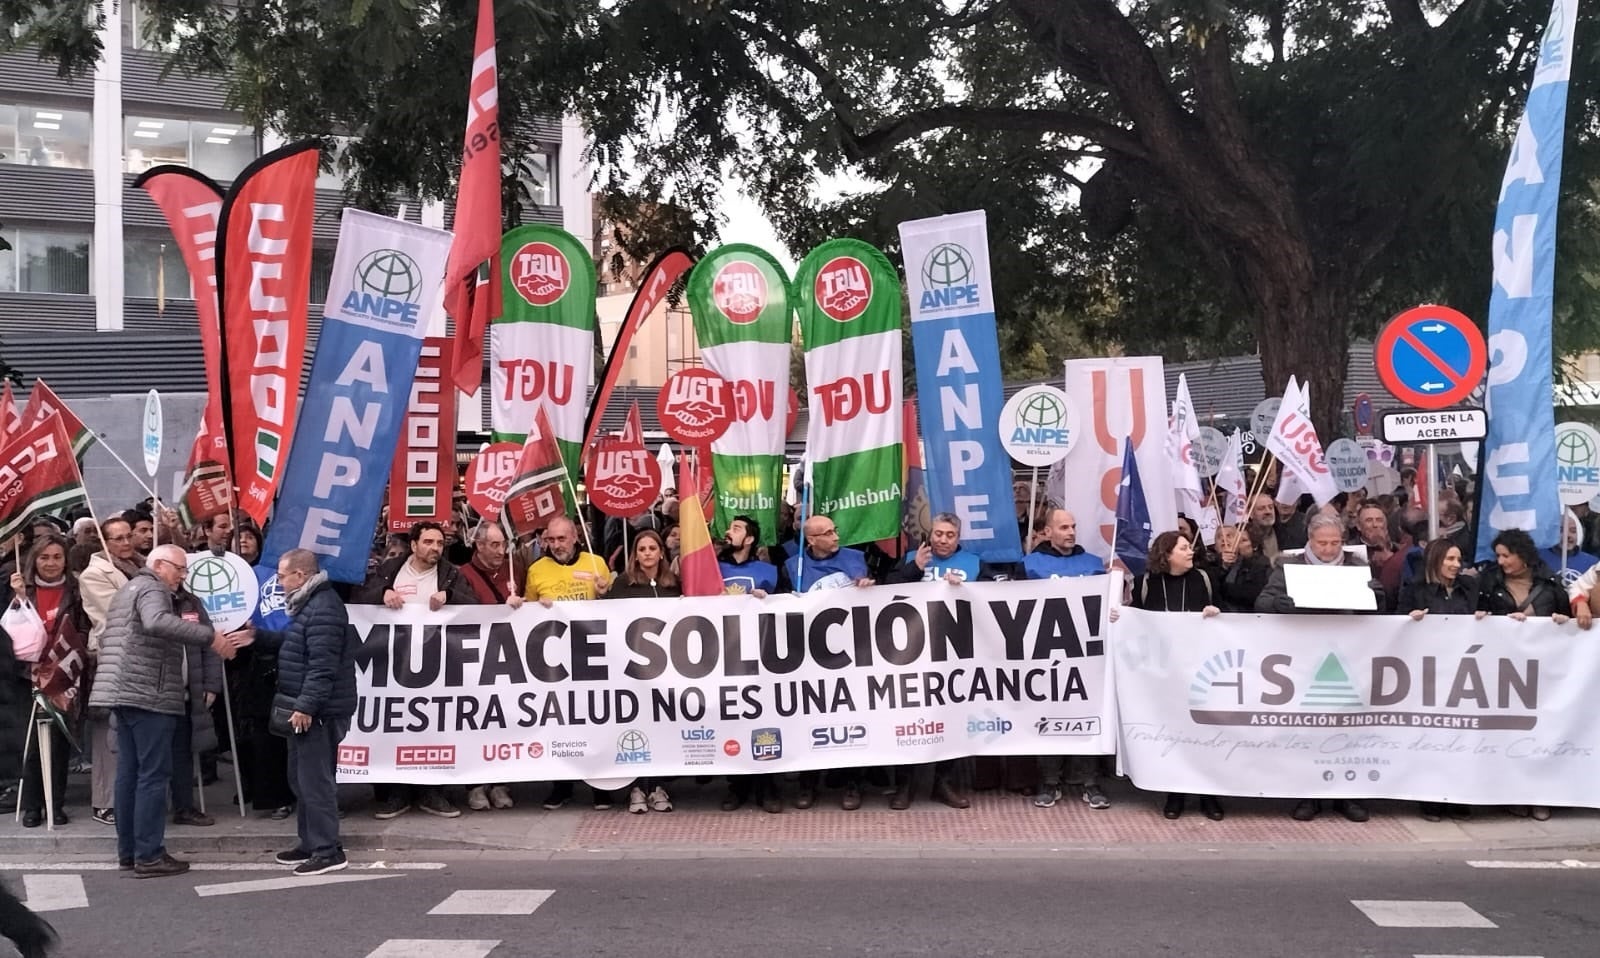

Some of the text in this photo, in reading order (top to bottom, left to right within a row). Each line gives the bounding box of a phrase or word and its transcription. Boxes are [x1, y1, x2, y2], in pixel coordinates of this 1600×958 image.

[920, 284, 979, 309] ANPE
[248, 202, 289, 427] CCOO
[342, 290, 421, 325] ANPE
[669, 376, 723, 404] UGT
[1396, 413, 1474, 425] MOTOS EN LA
[936, 328, 994, 540] ANPE
[1010, 427, 1069, 444] ANPE
[1417, 428, 1457, 438] ACERA
[297, 340, 390, 559] ANPE
[596, 450, 648, 480] UGT
[1557, 466, 1600, 483] NPE
[203, 591, 247, 612] NPE
[349, 594, 1104, 689] MUFACE SOLUCIÓN YA!
[357, 660, 1089, 734] UESTRA SALUD NO ES UNA MERCANCÍA
[966, 717, 1013, 734] acaip
[1053, 720, 1096, 731] SIAT
[1250, 711, 1480, 728] ASOCIACIÓN SINDICAL DOCENTE
[681, 725, 716, 740] usie
[811, 725, 867, 746] SUP
[896, 735, 945, 747] federación
[551, 740, 588, 749] Servicios
[753, 745, 781, 756] UFP
[1123, 723, 1230, 758] Trabajando
[1226, 737, 1281, 761] para
[1319, 733, 1400, 754] Centros
[1505, 737, 1593, 759] Centros
[341, 749, 366, 762] OO
[399, 748, 453, 761] CCOO
[482, 743, 524, 761] UGT
[551, 749, 585, 758] Públicos
[615, 751, 652, 762] ANPE
